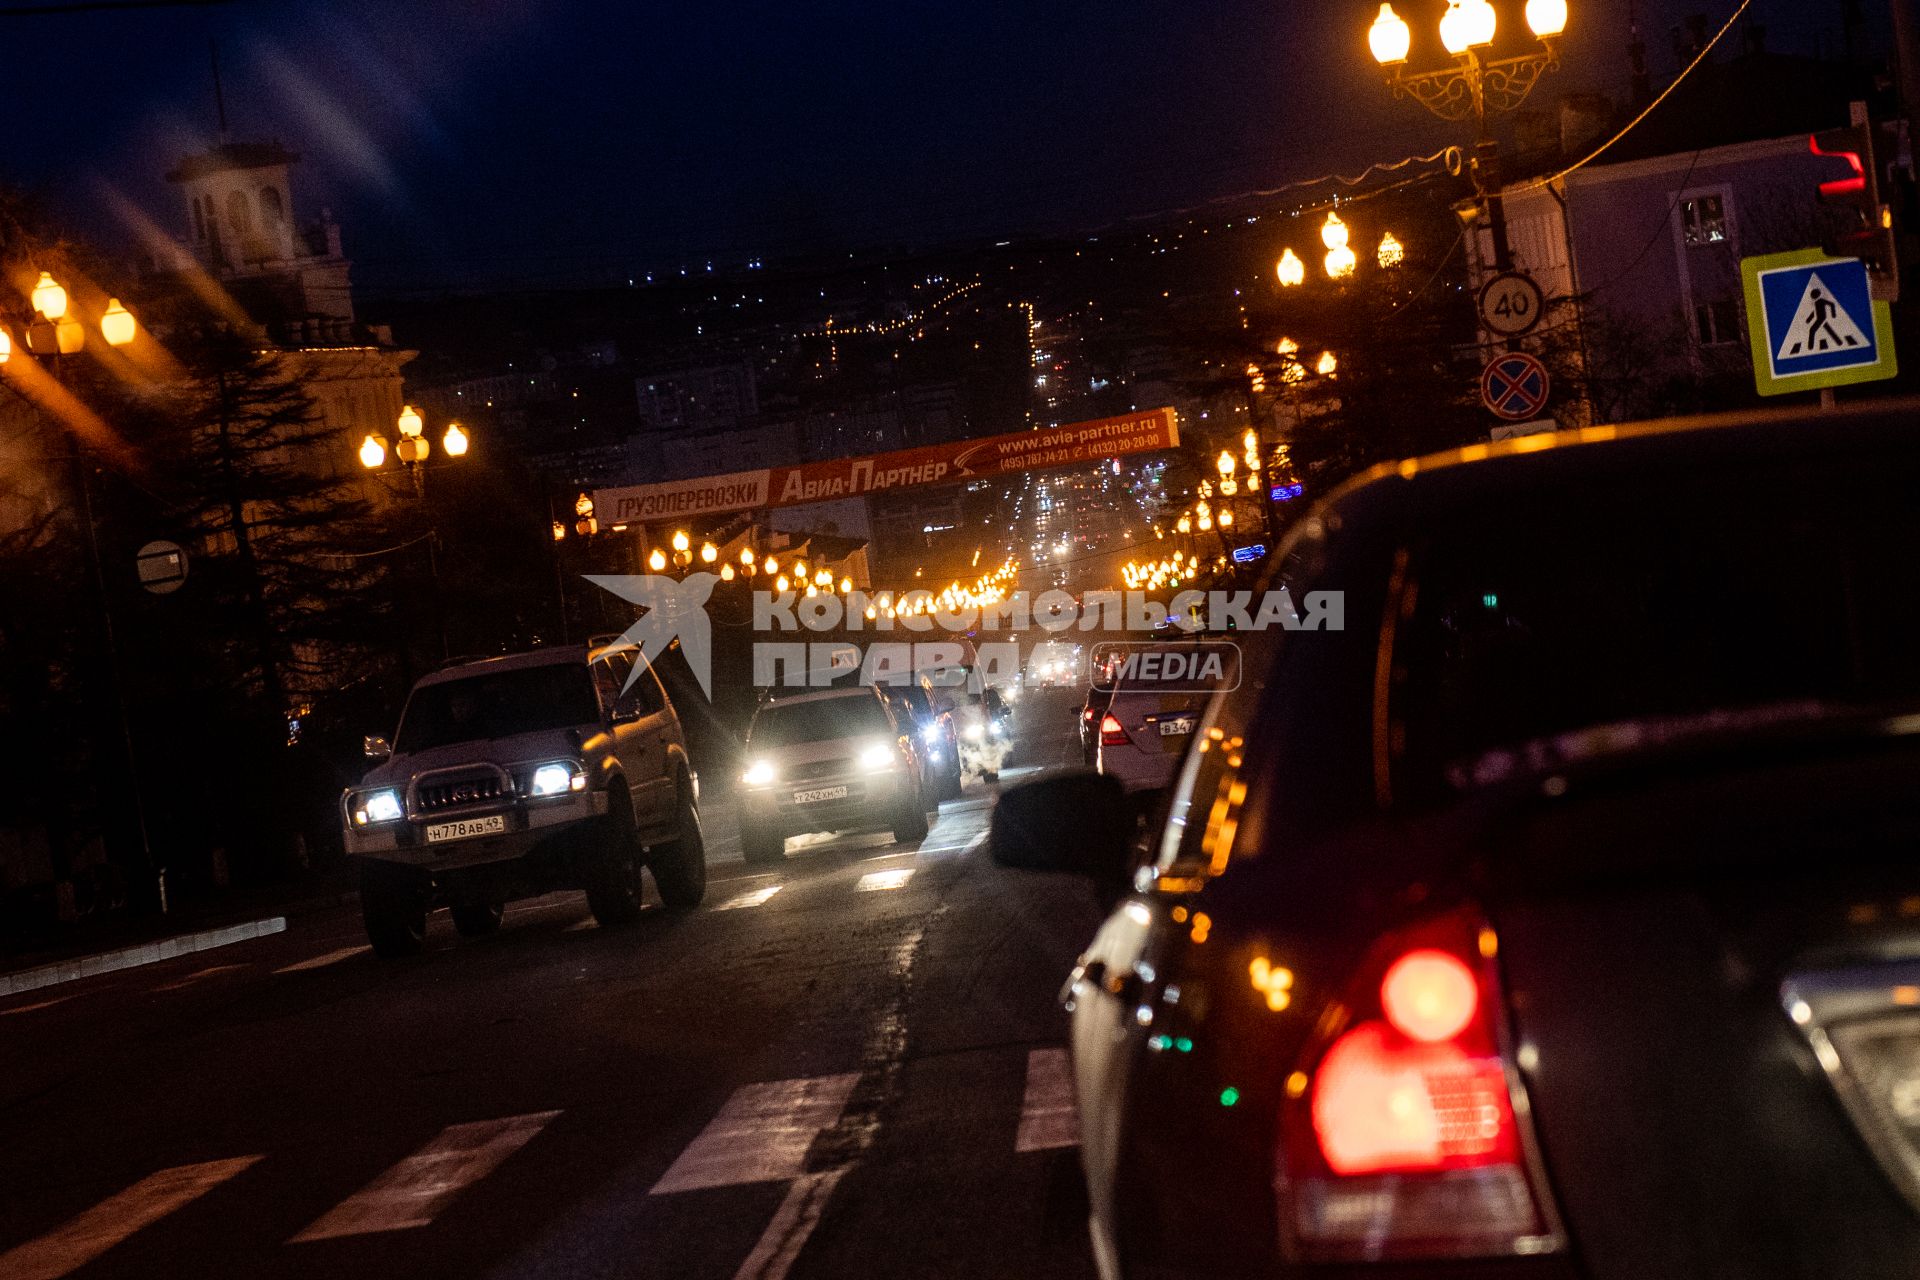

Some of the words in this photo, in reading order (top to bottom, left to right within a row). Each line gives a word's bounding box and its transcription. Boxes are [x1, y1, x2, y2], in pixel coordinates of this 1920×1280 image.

[1495, 291, 1528, 317] 40
[998, 417, 1157, 453] www.avia-partner.ru
[1000, 457, 1025, 471] (495)
[1027, 448, 1069, 466] 787-74-21
[1088, 440, 1118, 458] (4132)
[1118, 433, 1159, 452] 20-20-00
[616, 482, 758, 518] ГРУЗОПЕРЕВОЗКИ
